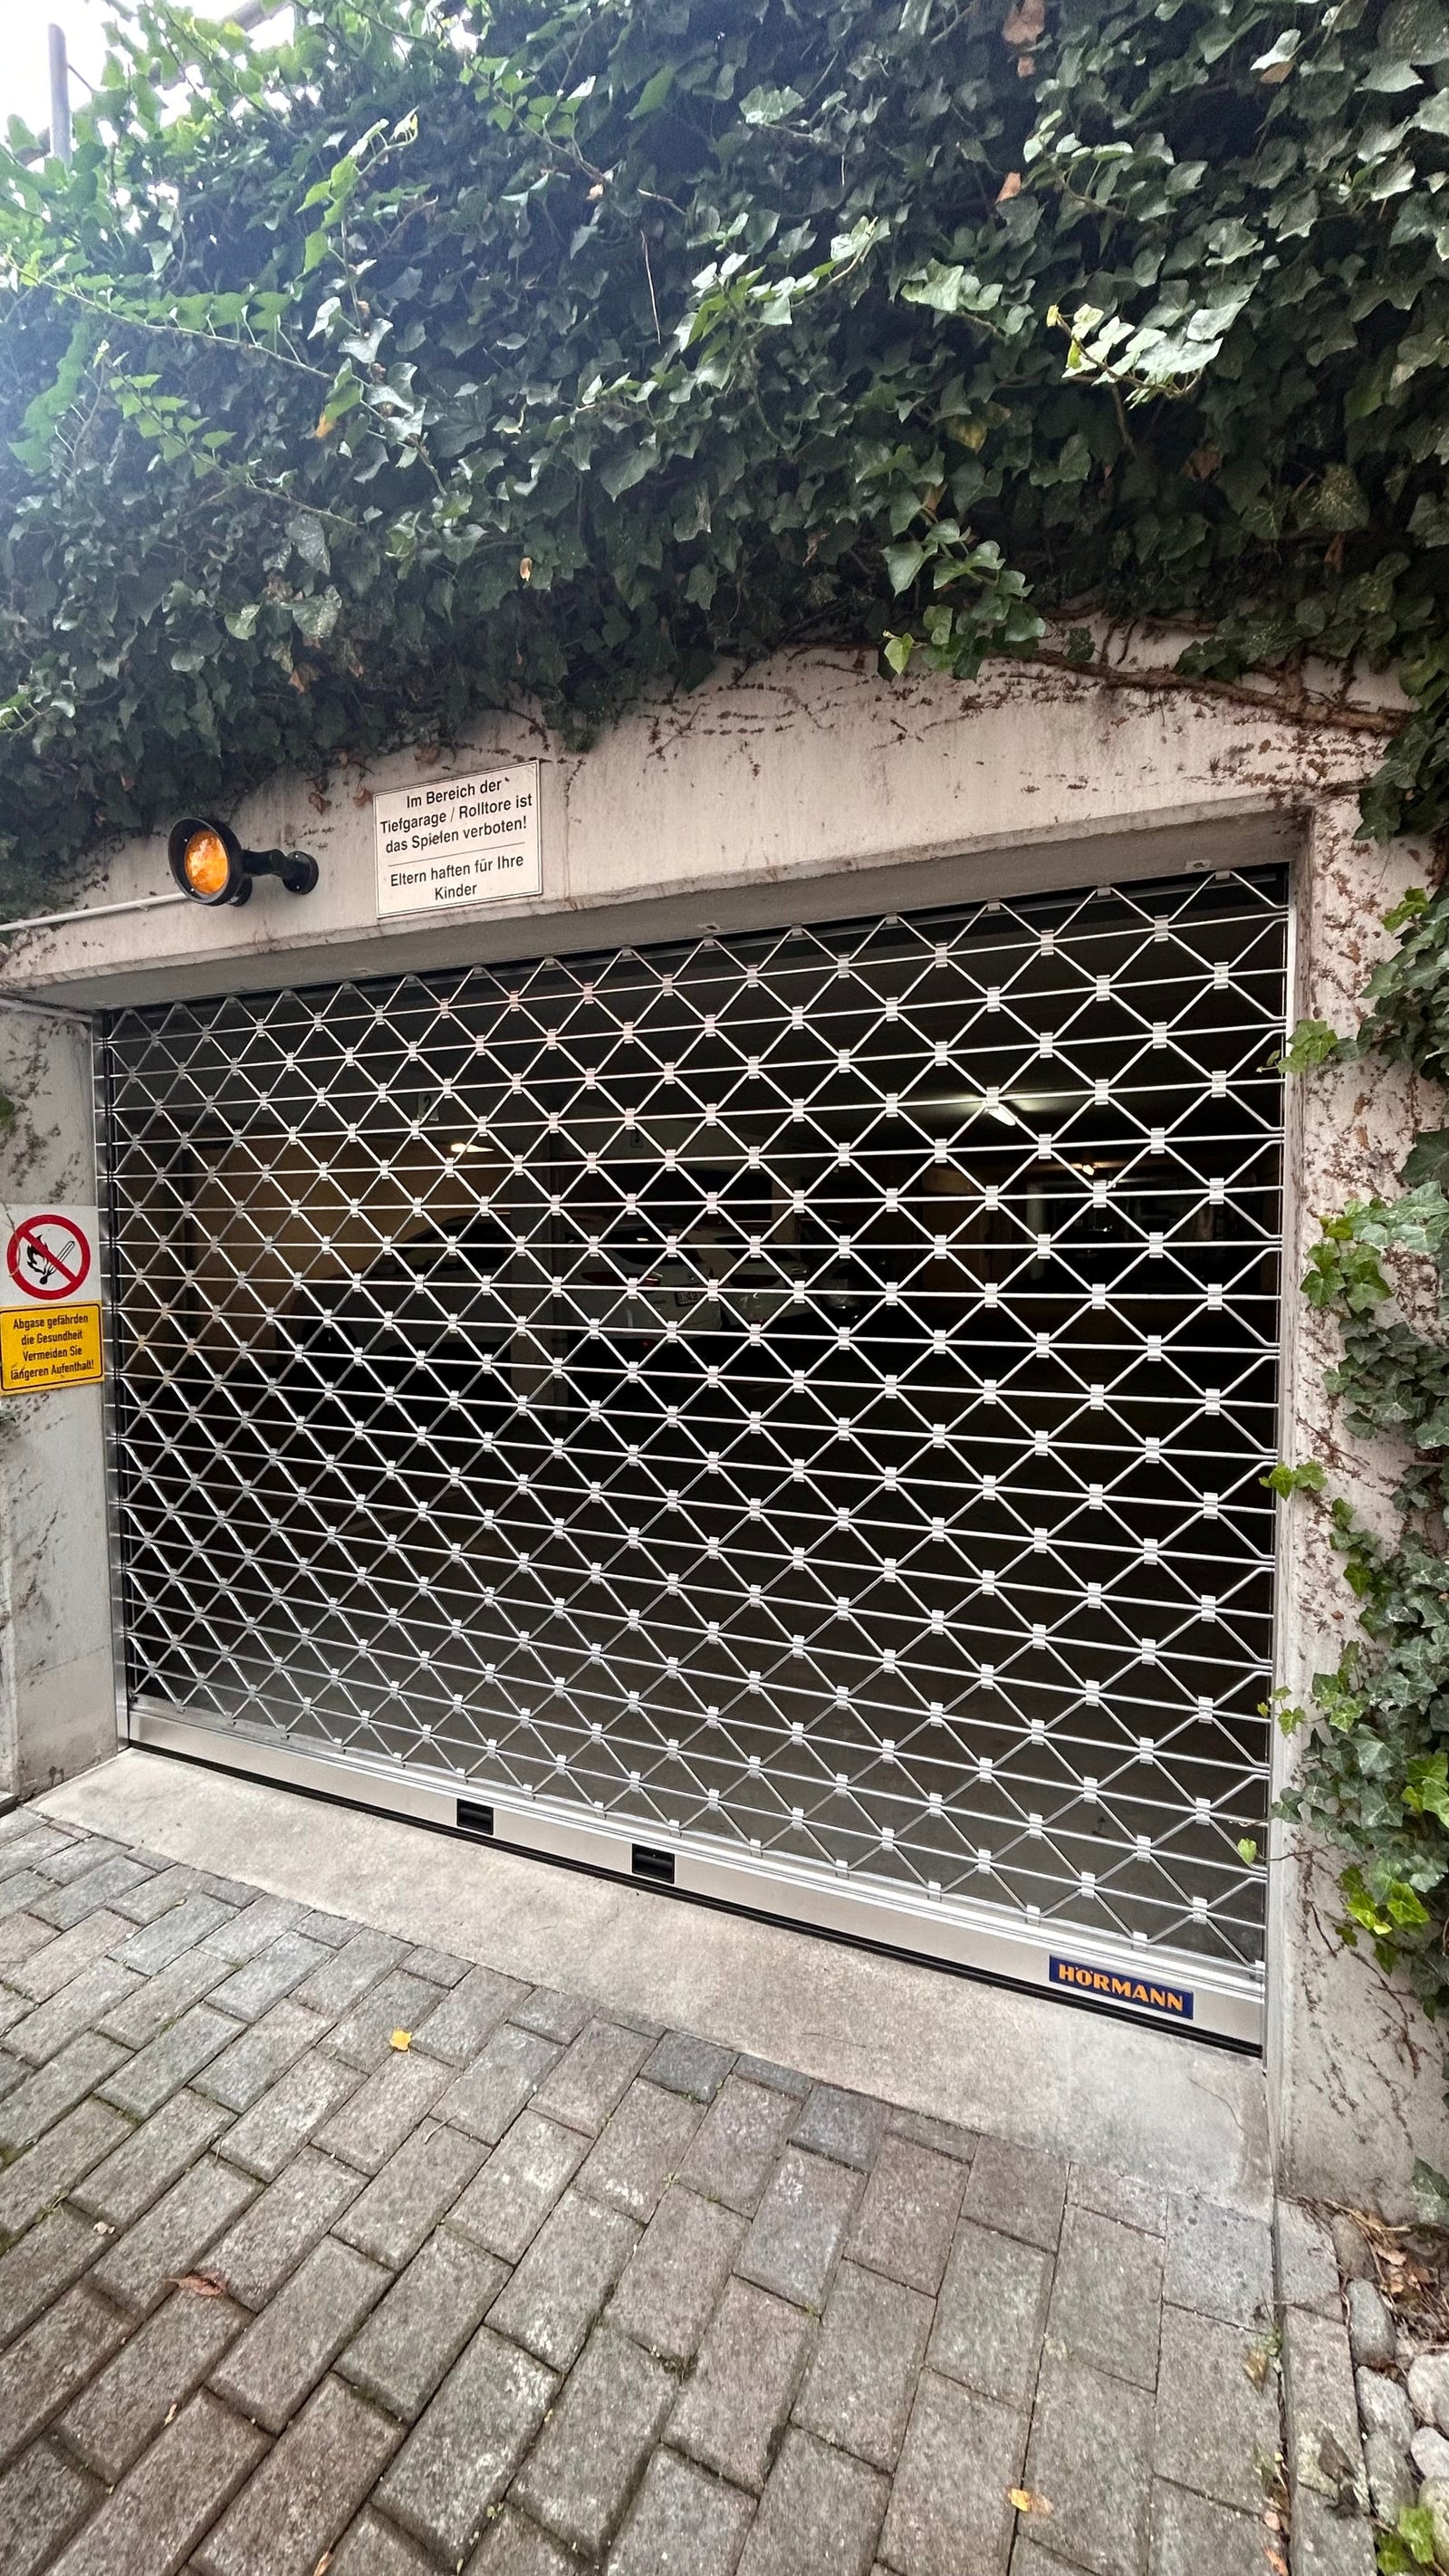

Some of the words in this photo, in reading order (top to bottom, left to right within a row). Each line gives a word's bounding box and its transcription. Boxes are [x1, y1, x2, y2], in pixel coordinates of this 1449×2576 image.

[407, 795, 421, 808] Im
[427, 783, 475, 804] Bereich
[480, 779, 502, 793] der
[380, 811, 446, 833] Tiefgarage
[450, 808, 455, 822] /
[459, 799, 511, 819] Rolltore
[516, 793, 533, 809] ist
[386, 839, 408, 852] das
[412, 830, 458, 851] Spielen
[463, 816, 527, 839] verboten!
[390, 871, 427, 886] Eltern
[431, 862, 470, 880] haften
[475, 859, 493, 873] für
[498, 855, 523, 870] Ihre
[435, 883, 477, 900] Kinder
[14, 1317, 44, 1331] Abgase
[47, 1314, 88, 1329] gefährden
[22, 1334, 35, 1345] die
[37, 1330, 82, 1344] Gesundheit
[23, 1349, 67, 1361] Vermeiden
[70, 1345, 82, 1356] Sie
[11, 1366, 49, 1380] längeren
[52, 1360, 94, 1374] Aufenthalt!
[1059, 1963, 1183, 2012] HÖRMANN
